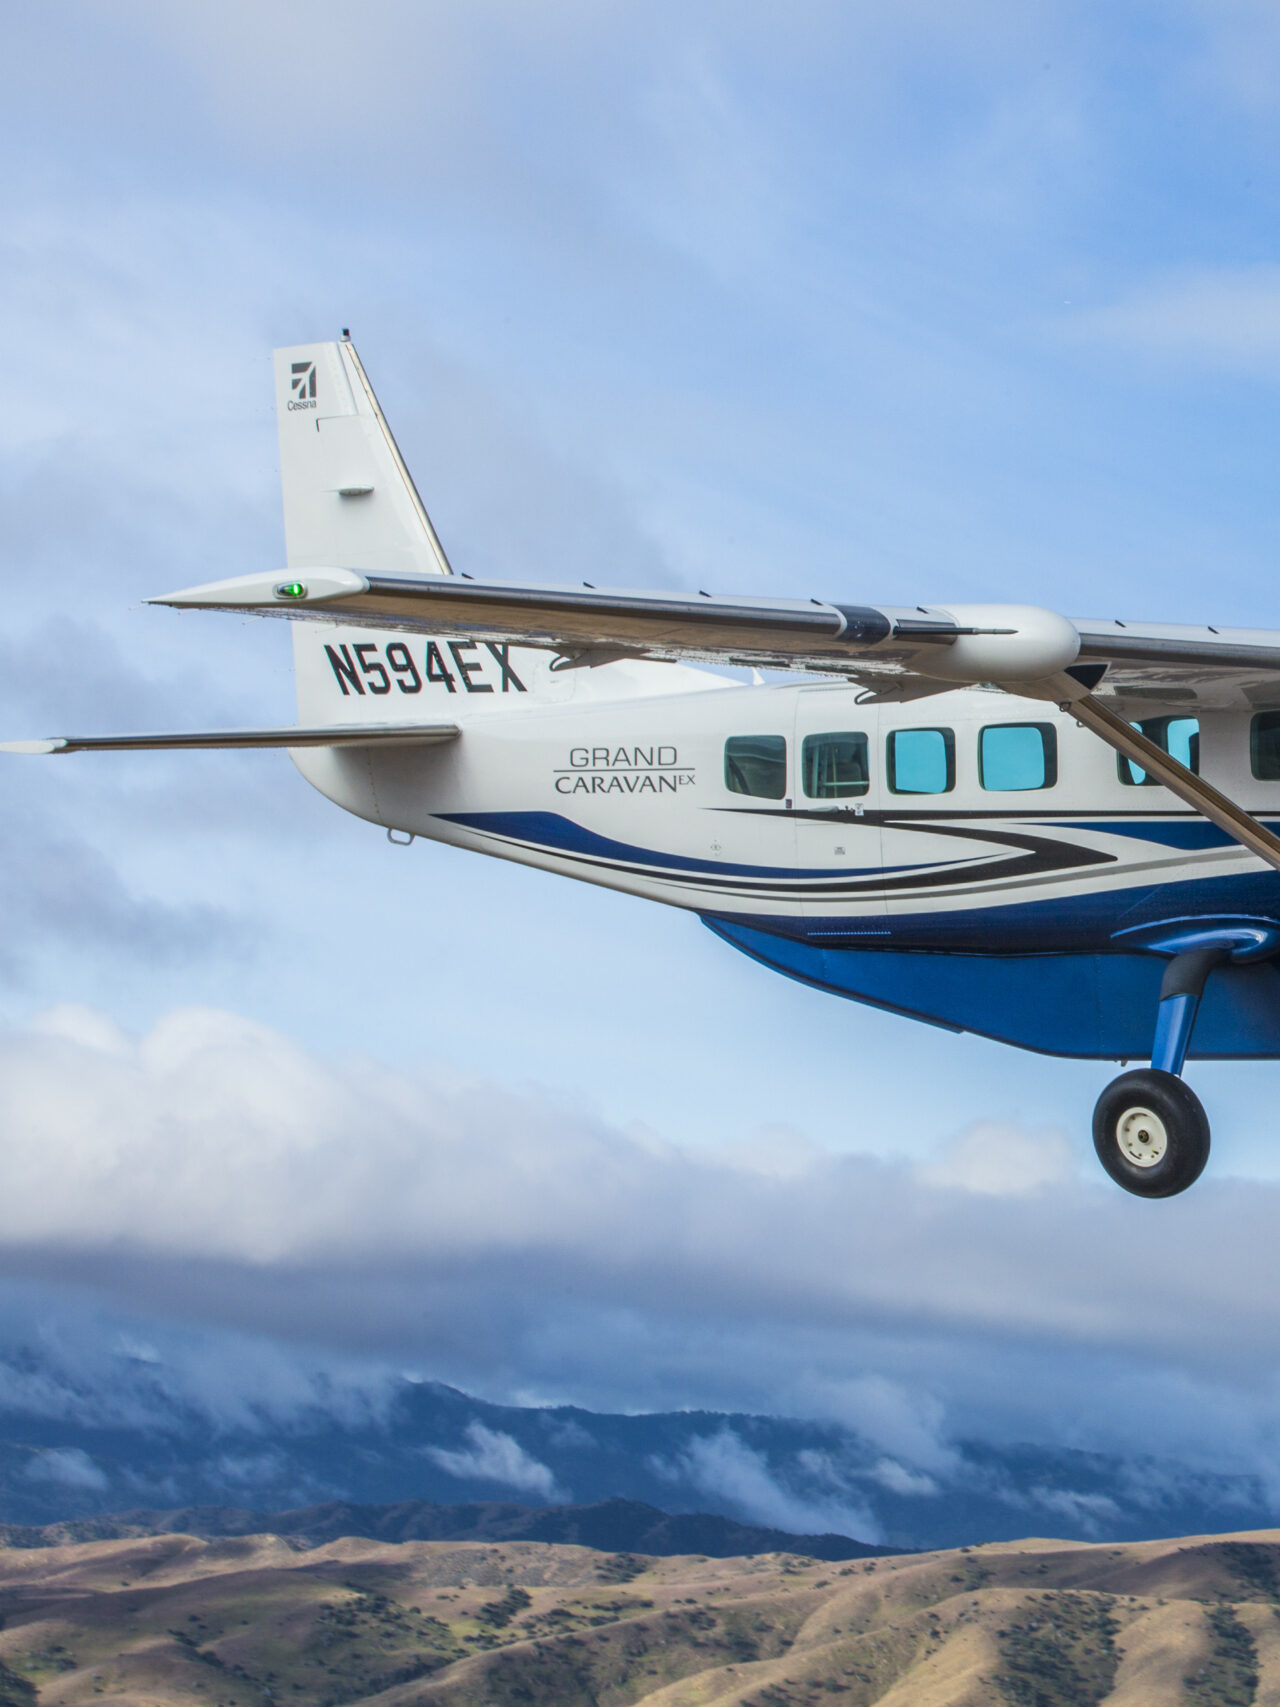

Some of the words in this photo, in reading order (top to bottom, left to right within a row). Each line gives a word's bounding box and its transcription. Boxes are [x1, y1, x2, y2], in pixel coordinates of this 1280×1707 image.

[287, 399, 317, 411] Cessna
[324, 641, 528, 696] N594EX
[569, 746, 678, 768] GRAND
